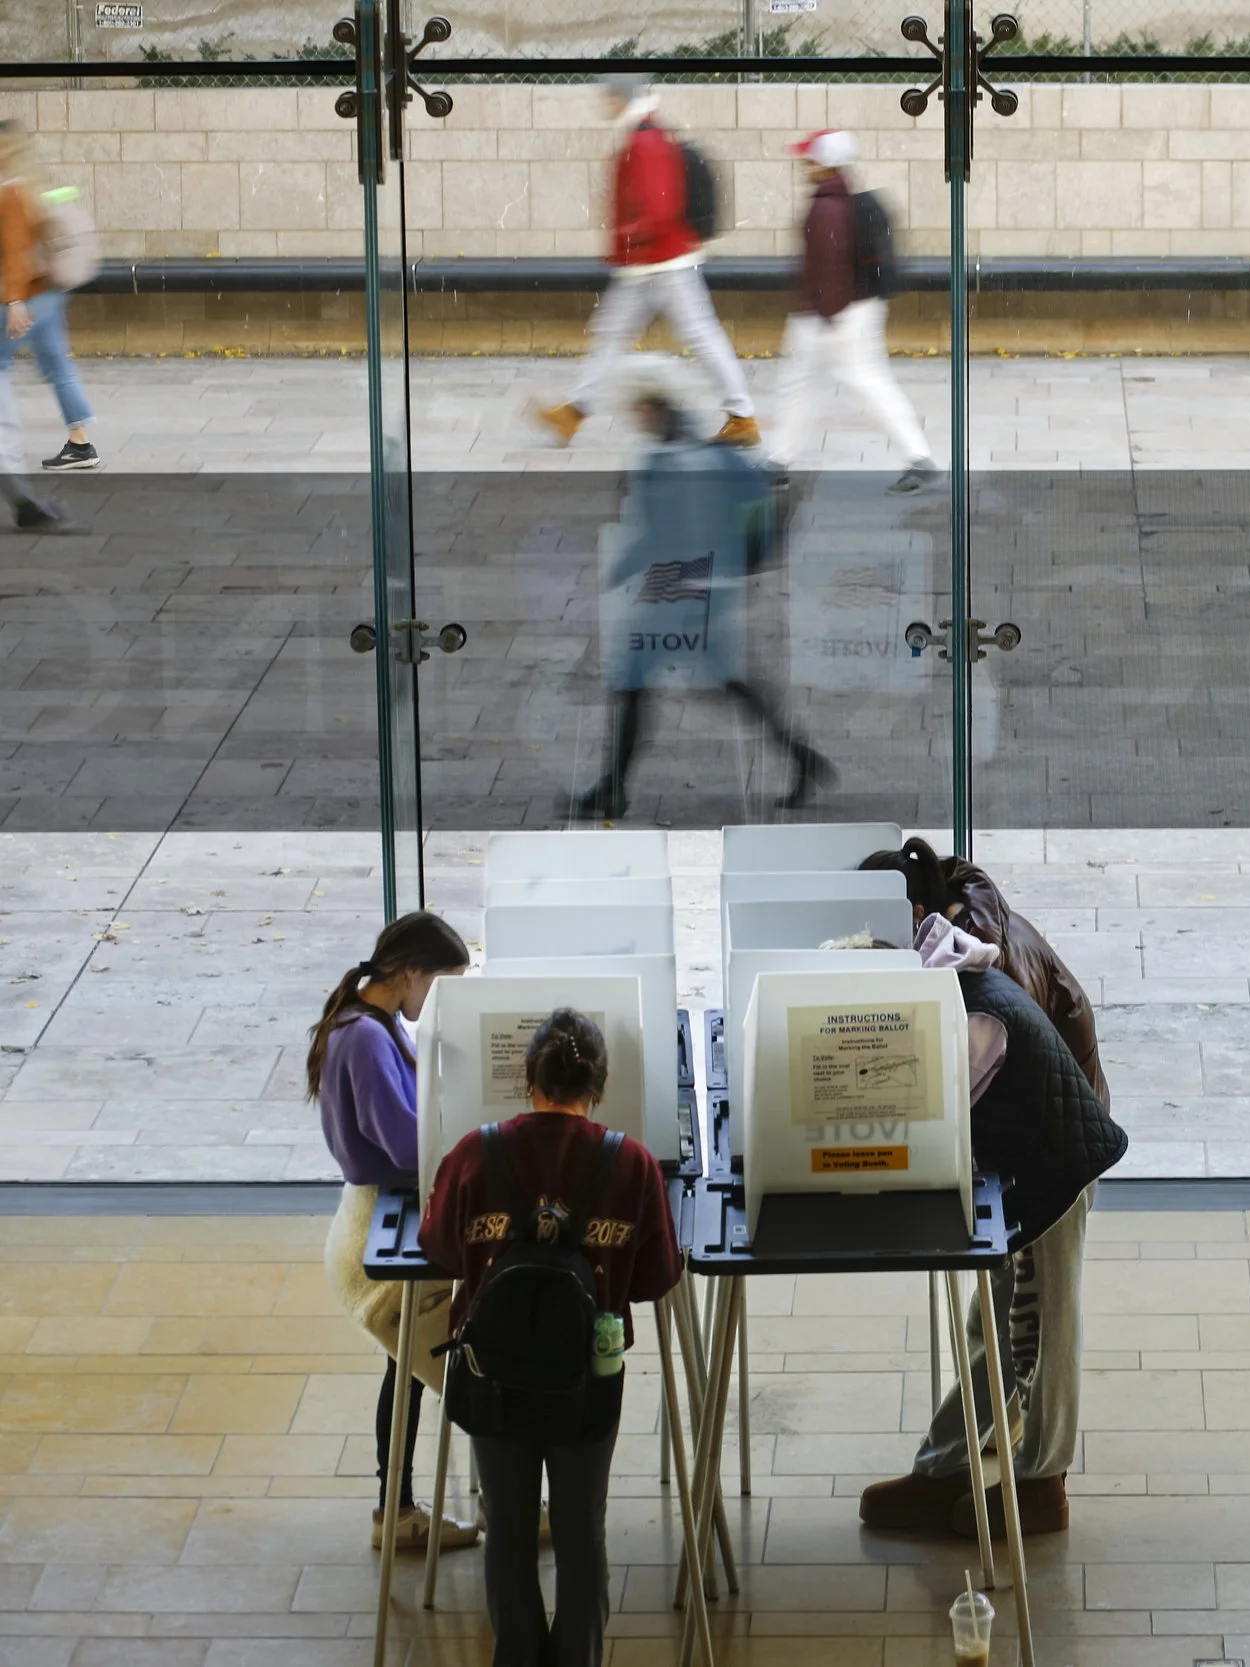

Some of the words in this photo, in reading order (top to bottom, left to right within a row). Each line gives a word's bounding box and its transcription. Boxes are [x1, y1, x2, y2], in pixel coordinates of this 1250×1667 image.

[98, 5, 140, 15] Federal
[828, 1013, 901, 1024] INSTRUCTIONS
[820, 1027, 836, 1035] FOR
[838, 1025, 877, 1034] MARKING
[878, 1023, 910, 1032] BALLOT
[833, 1160, 860, 1168] Voting
[584, 1216, 637, 1247] 2017
